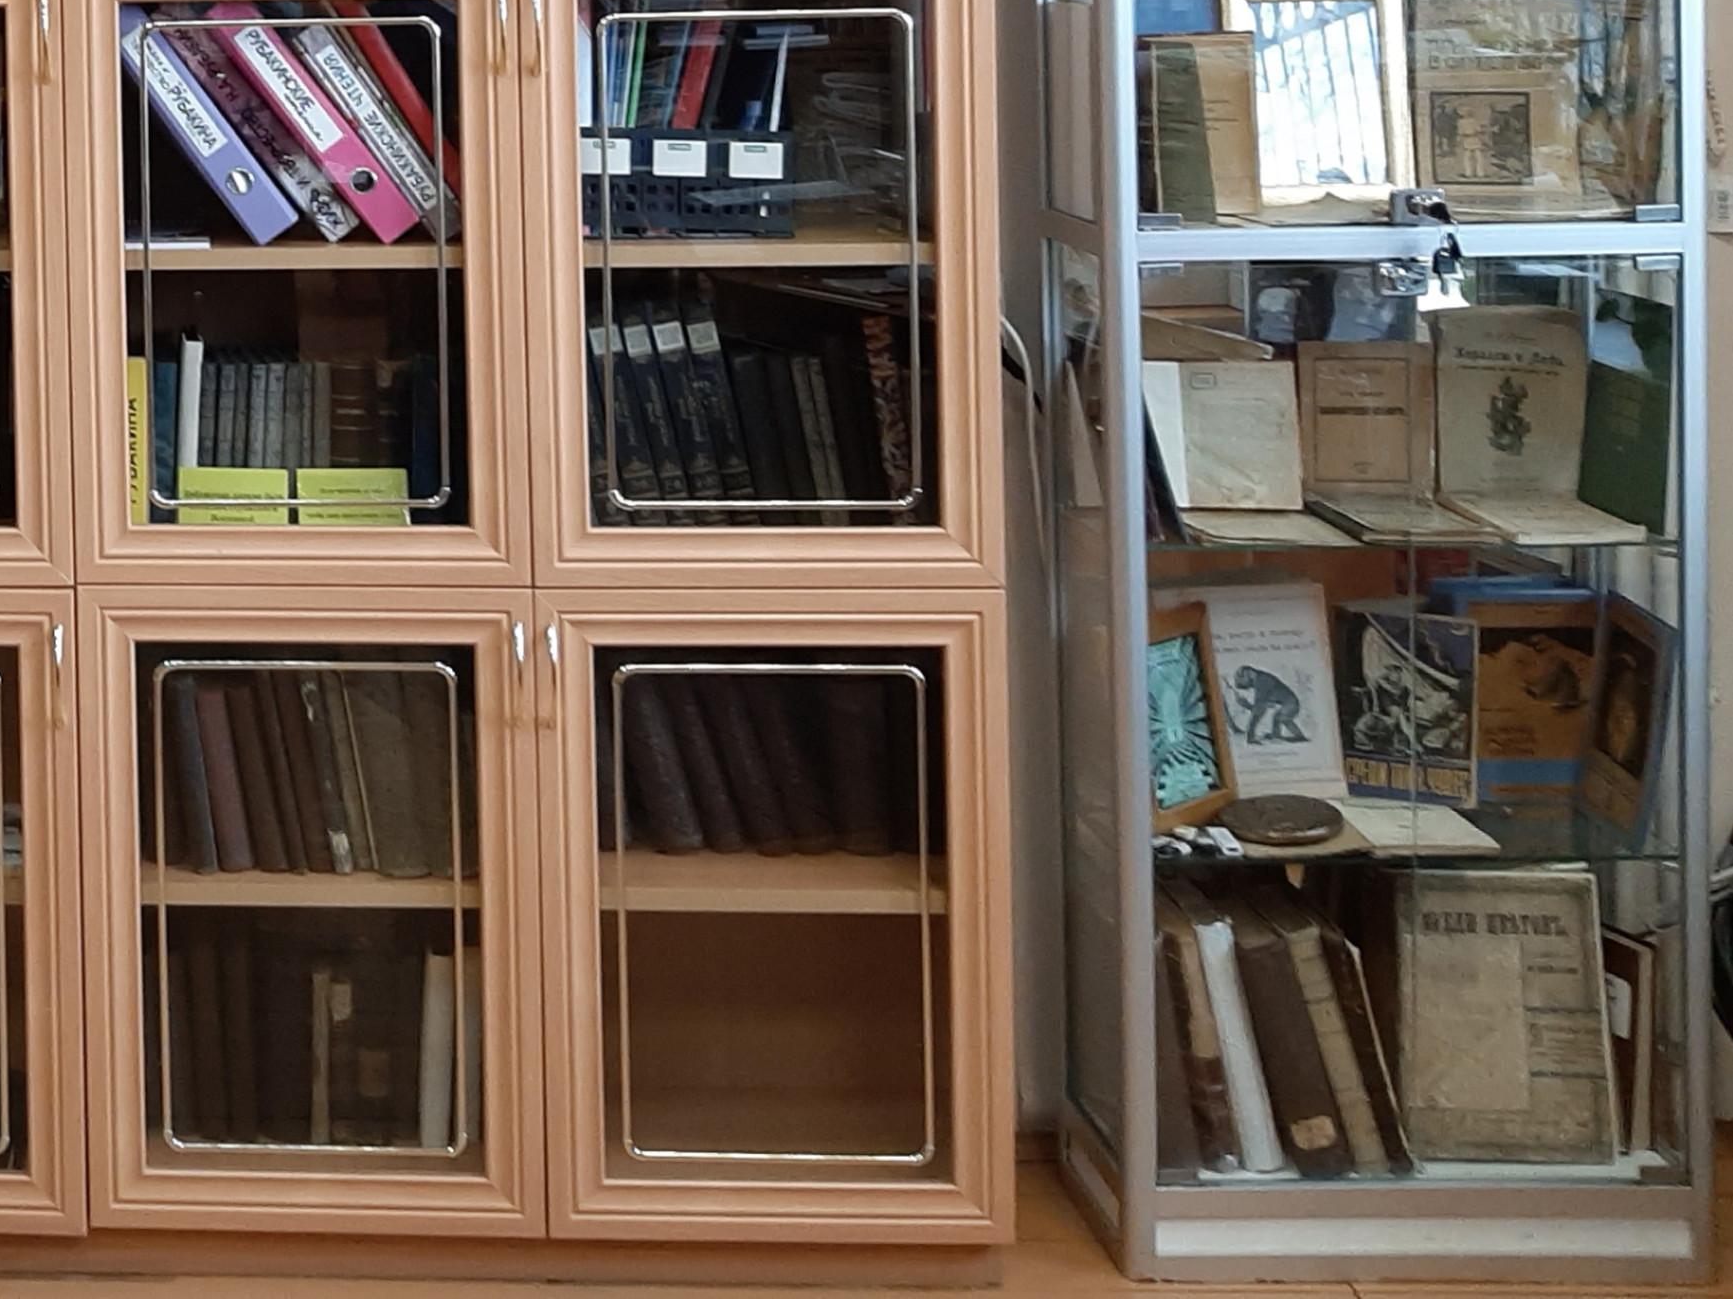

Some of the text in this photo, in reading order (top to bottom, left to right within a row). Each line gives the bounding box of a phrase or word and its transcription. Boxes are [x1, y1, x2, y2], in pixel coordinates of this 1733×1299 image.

[244, 29, 315, 112] РУБАКИНСКИЕ
[167, 84, 219, 151] РУБАКИНА
[320, 51, 437, 204] РУБАКИНСКИЕ ЧТЕНИЯ
